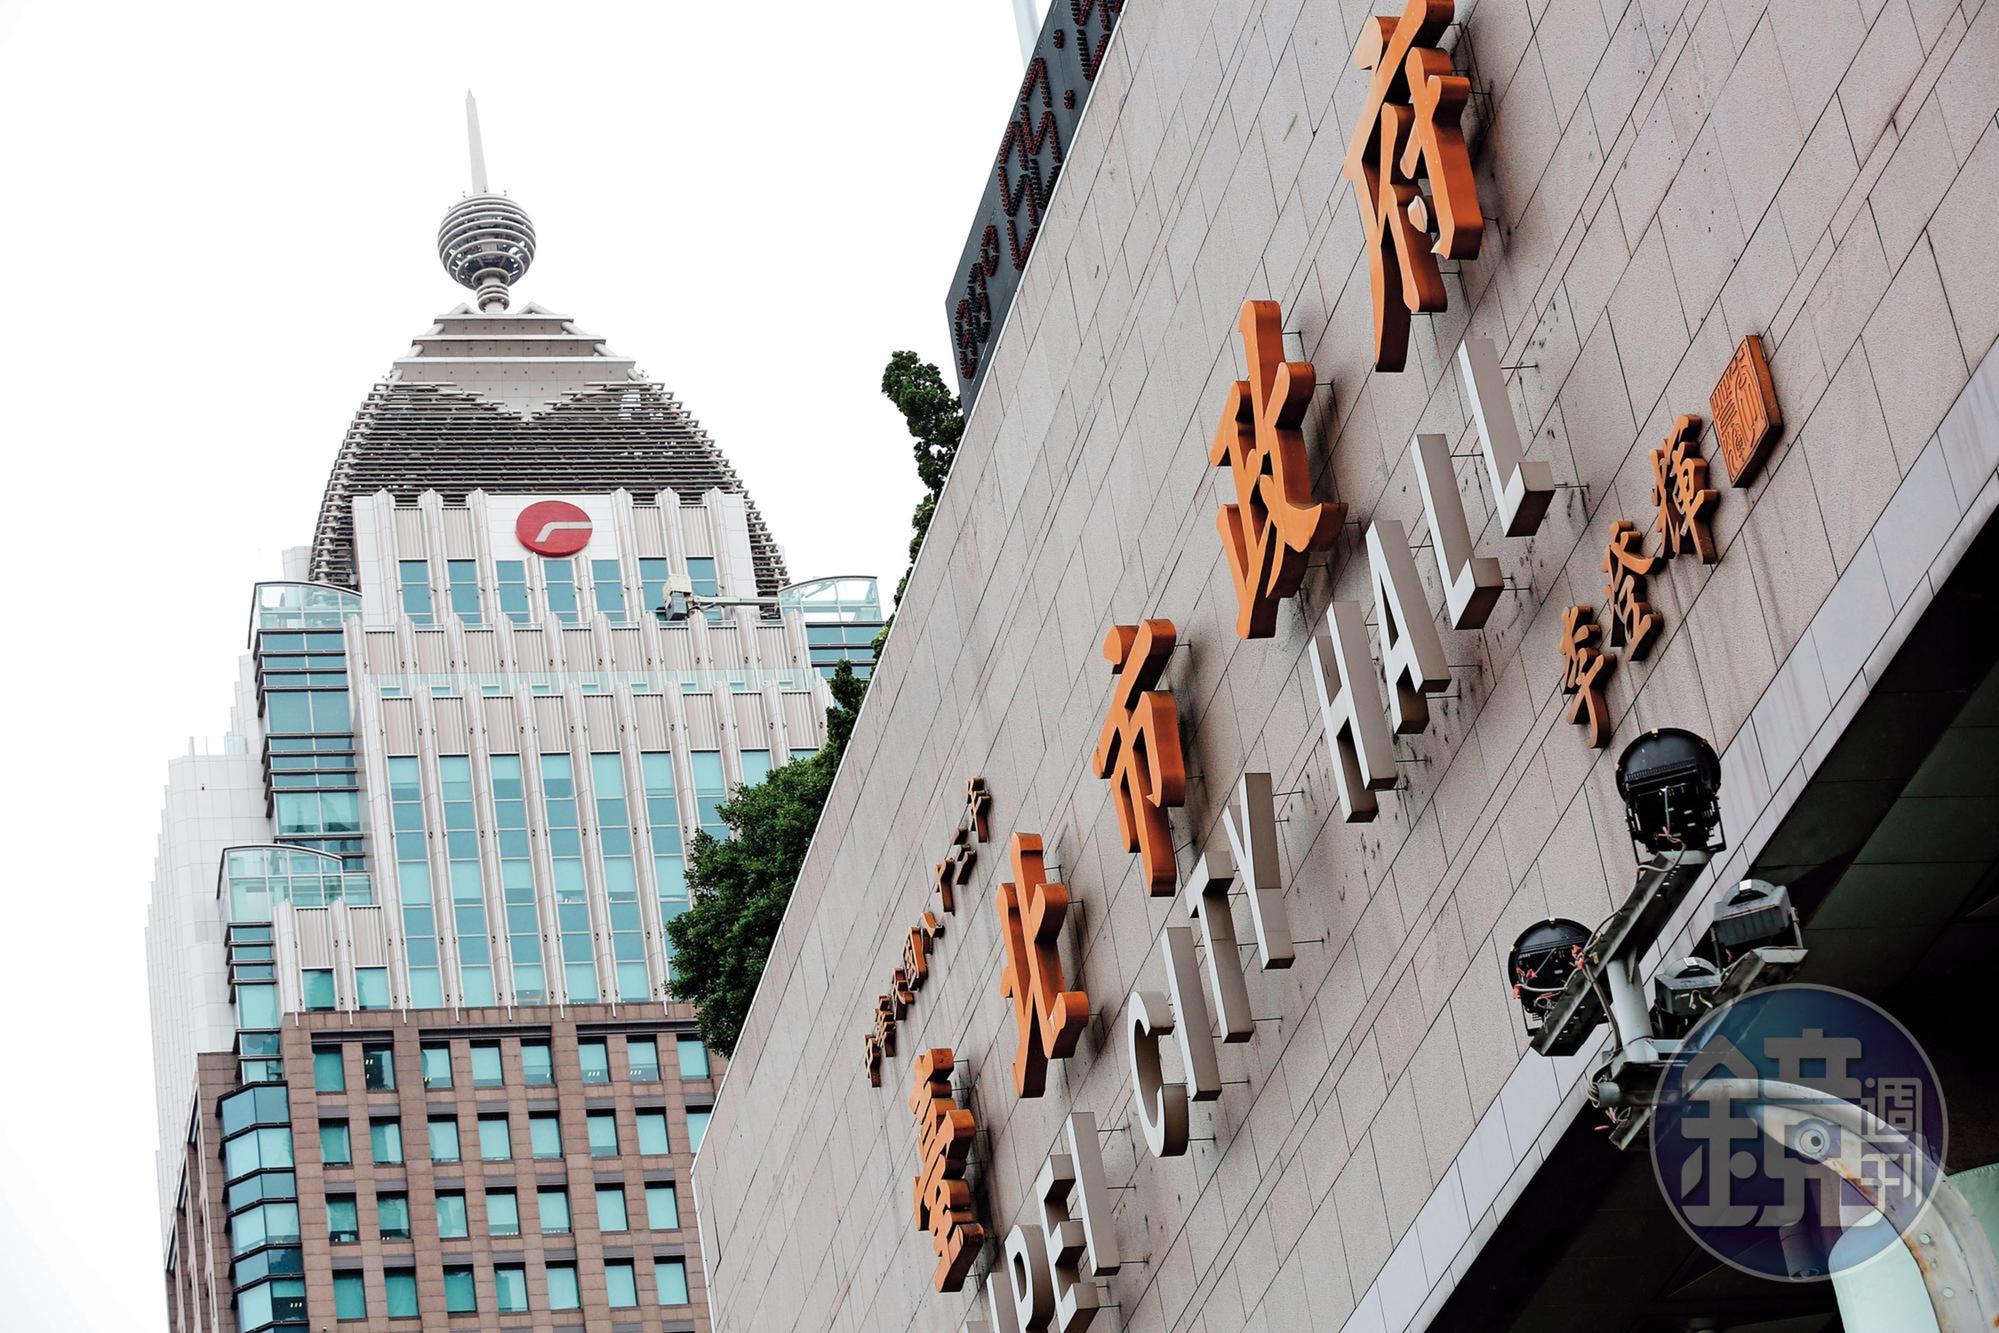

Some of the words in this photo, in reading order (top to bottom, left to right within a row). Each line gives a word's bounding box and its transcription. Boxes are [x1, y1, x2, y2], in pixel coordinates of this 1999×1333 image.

[908, 0, 1482, 1293] 臺北市政府
[1128, 773, 1294, 1156] CITY
[1309, 339, 1555, 823] HALL
[1560, 414, 1720, 749] 李登輝
